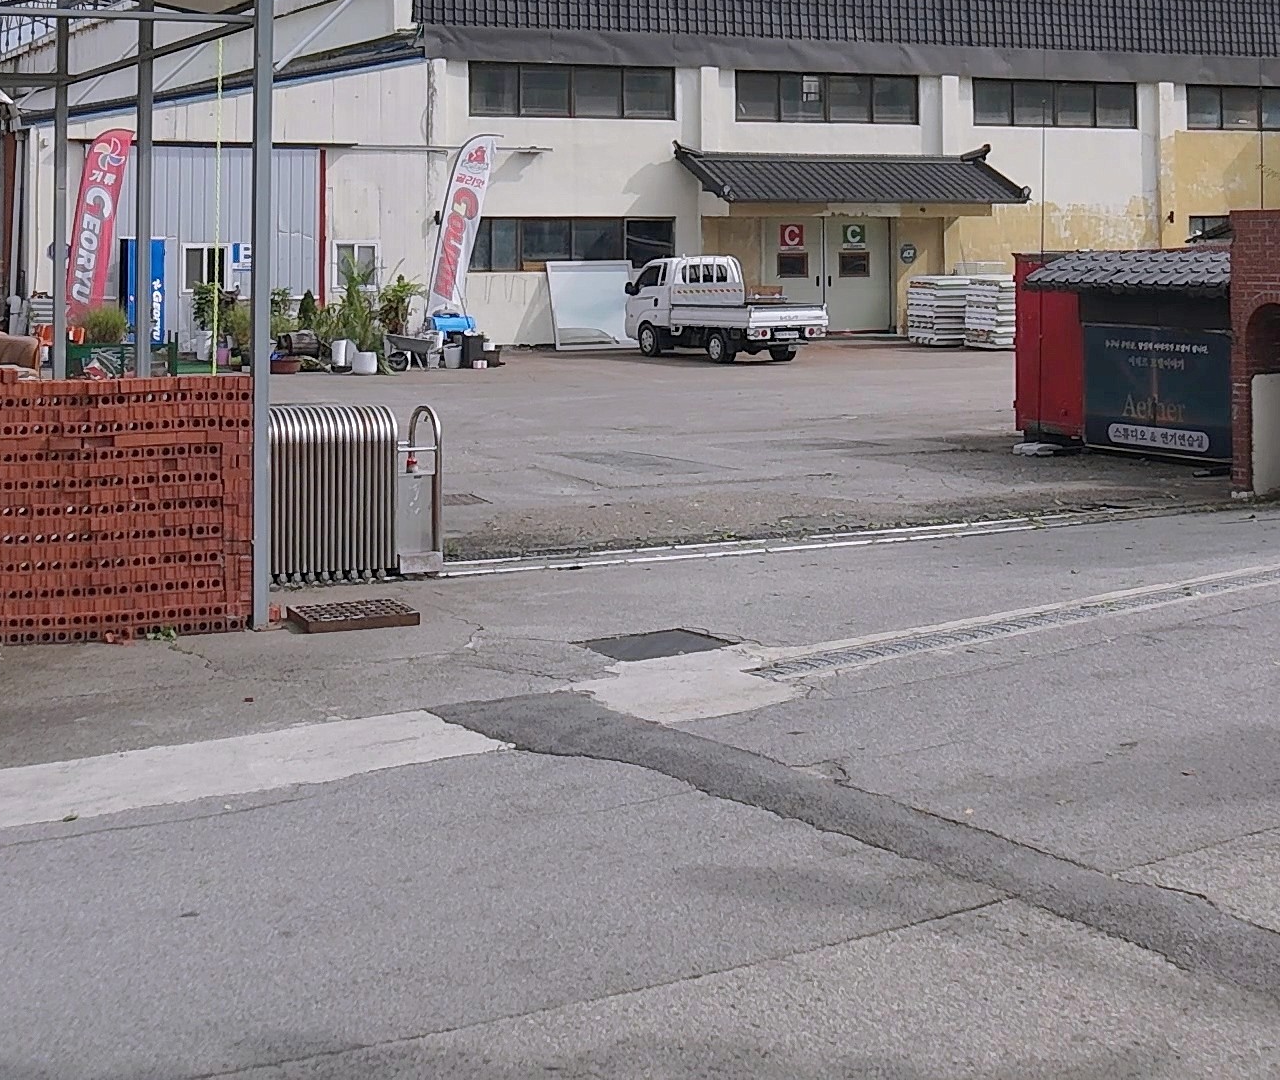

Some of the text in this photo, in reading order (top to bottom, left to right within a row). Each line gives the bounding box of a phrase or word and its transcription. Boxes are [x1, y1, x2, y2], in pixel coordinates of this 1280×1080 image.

[784, 225, 800, 246] C
[846, 225, 861, 243] C
[71, 186, 113, 305] GEORYU
[1121, 394, 1186, 423] Aether
[1113, 427, 1204, 449] 스튜디오 & 연기연습실
